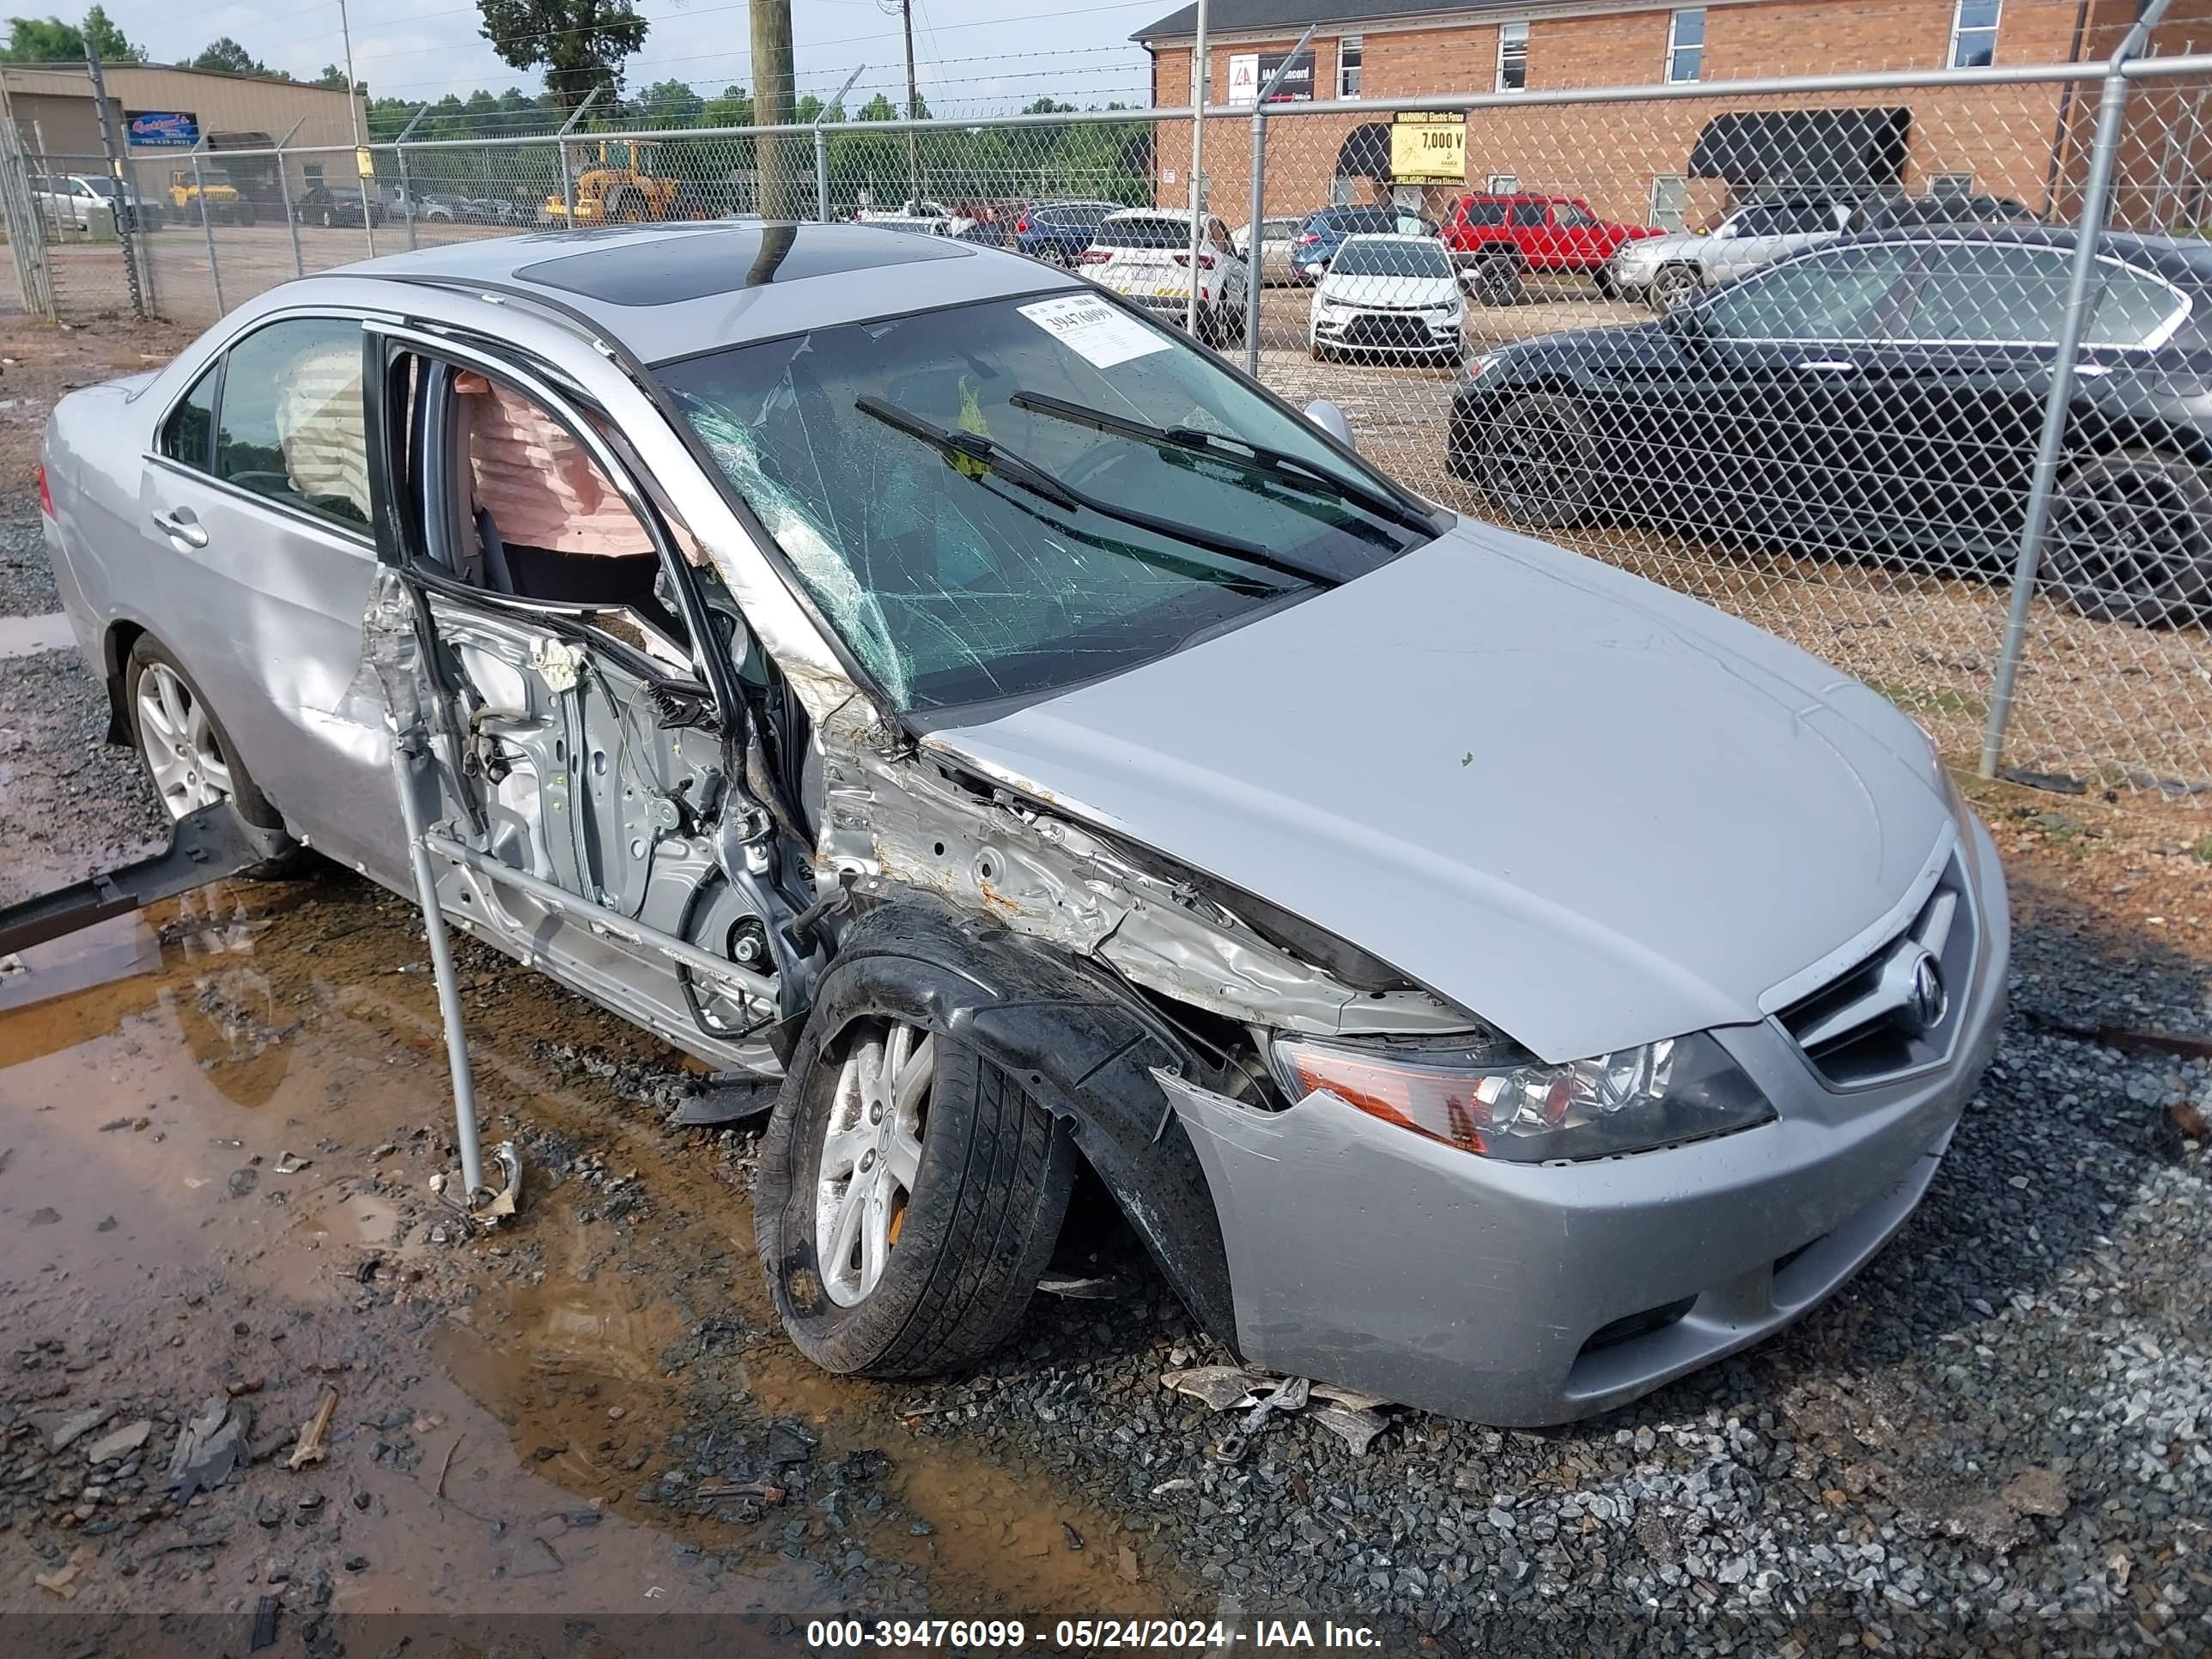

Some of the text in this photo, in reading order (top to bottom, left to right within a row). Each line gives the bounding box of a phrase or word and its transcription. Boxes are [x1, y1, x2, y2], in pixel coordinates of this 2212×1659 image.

[1397, 112, 1464, 123] WARNING! Electric Fence
[1422, 132, 1463, 150] 7,000 V
[1046, 307, 1114, 331] 39476099
